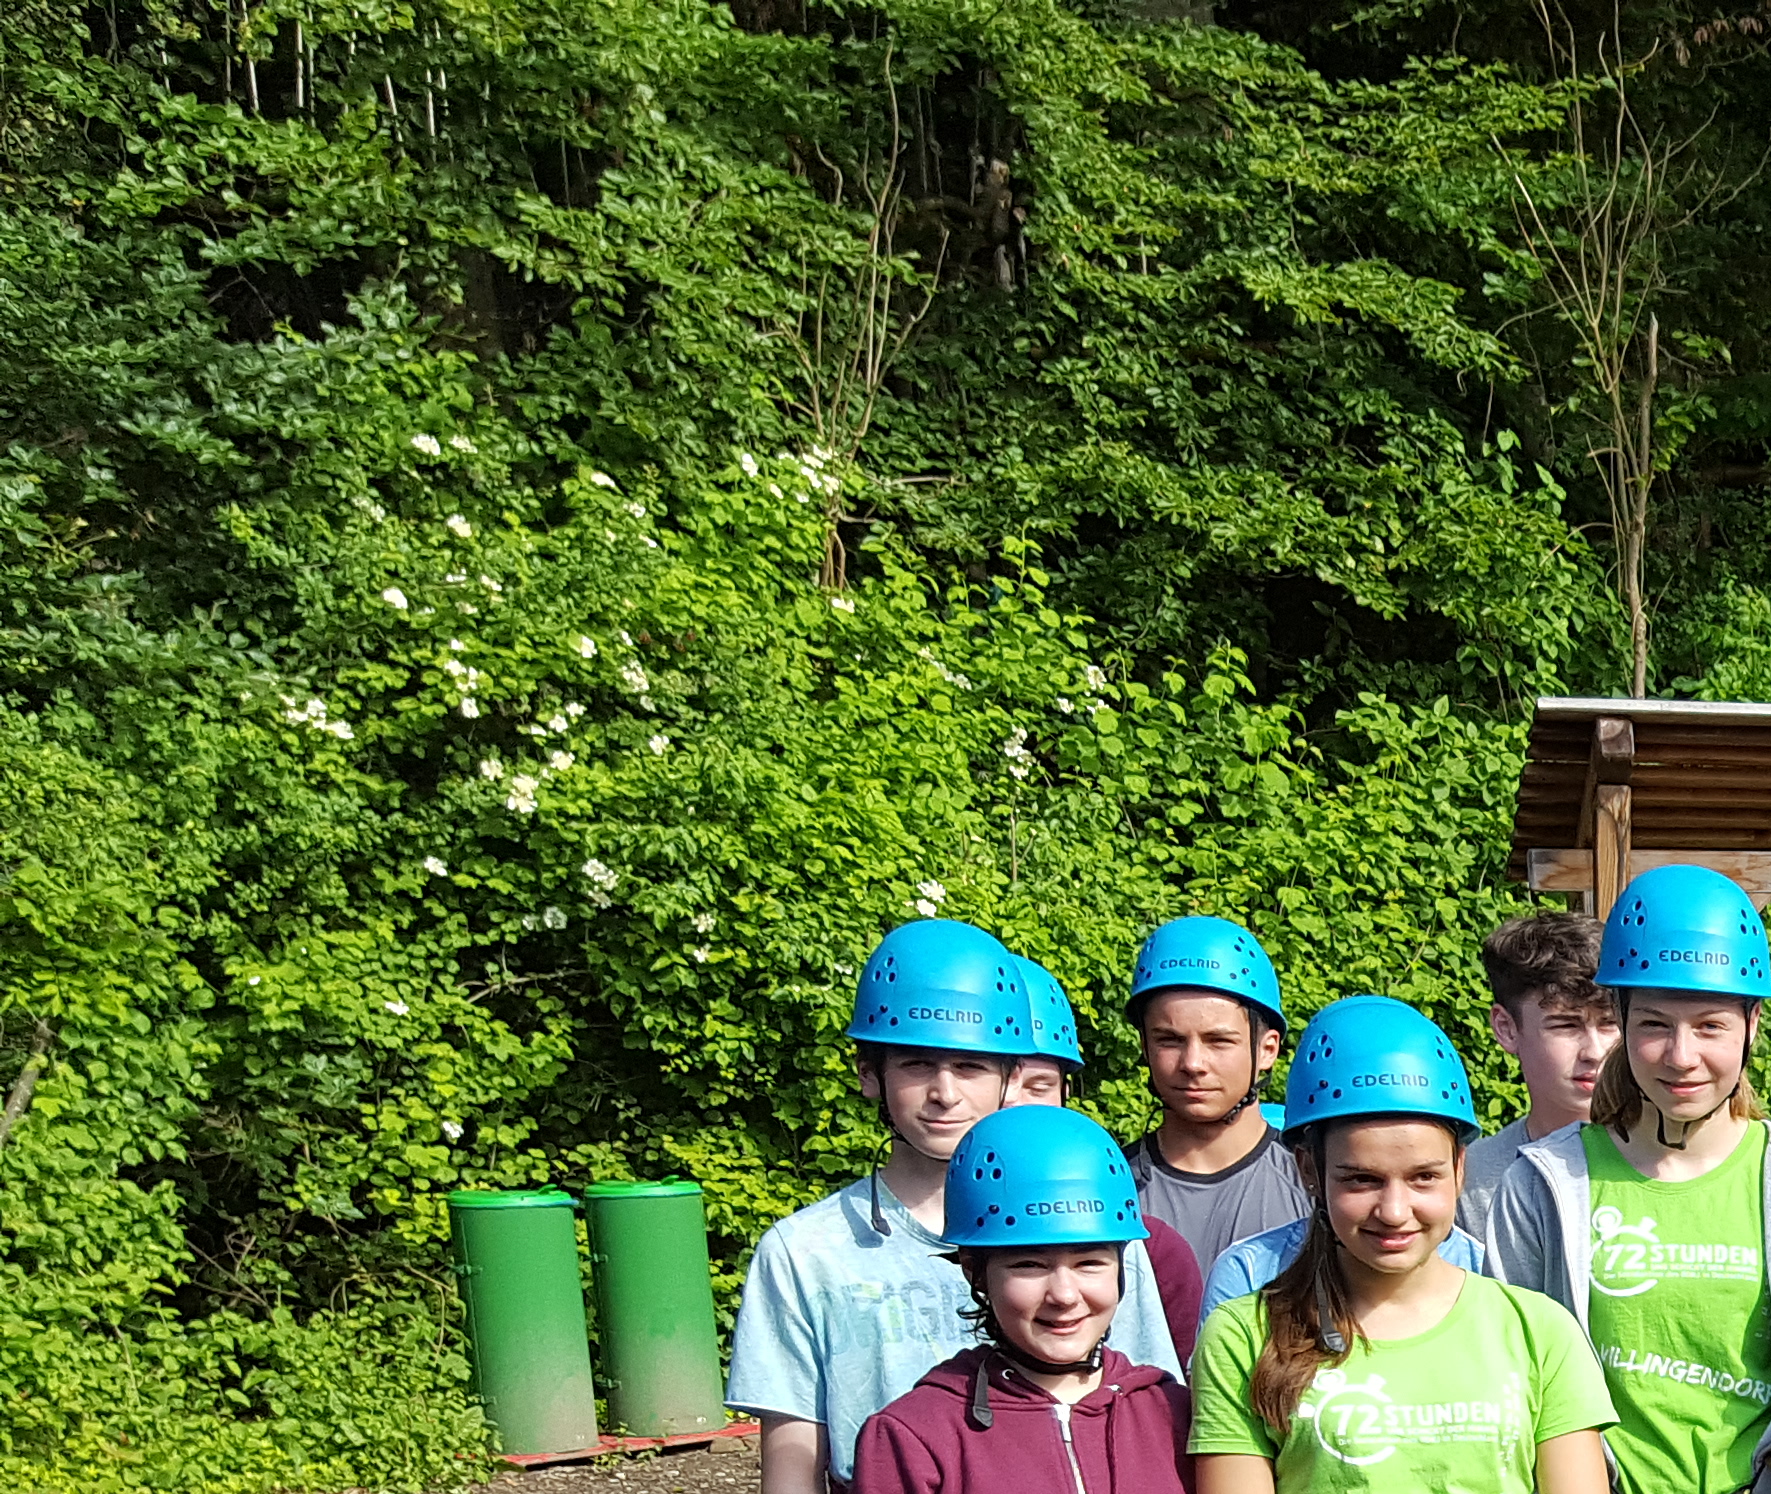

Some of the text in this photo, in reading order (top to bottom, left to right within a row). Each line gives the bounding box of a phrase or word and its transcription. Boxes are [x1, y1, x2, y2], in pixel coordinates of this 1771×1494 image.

[1160, 958, 1220, 969] EDELRID
[1659, 950, 1729, 965] EDELRID
[909, 1007, 982, 1024] EDELRID
[1352, 1074, 1428, 1087] EDELRID
[1025, 1200, 1104, 1216] EDELRID
[1603, 1244, 1758, 1271] 72 STUNDEN
[1331, 1401, 1502, 1435] 72 STUNDEN
